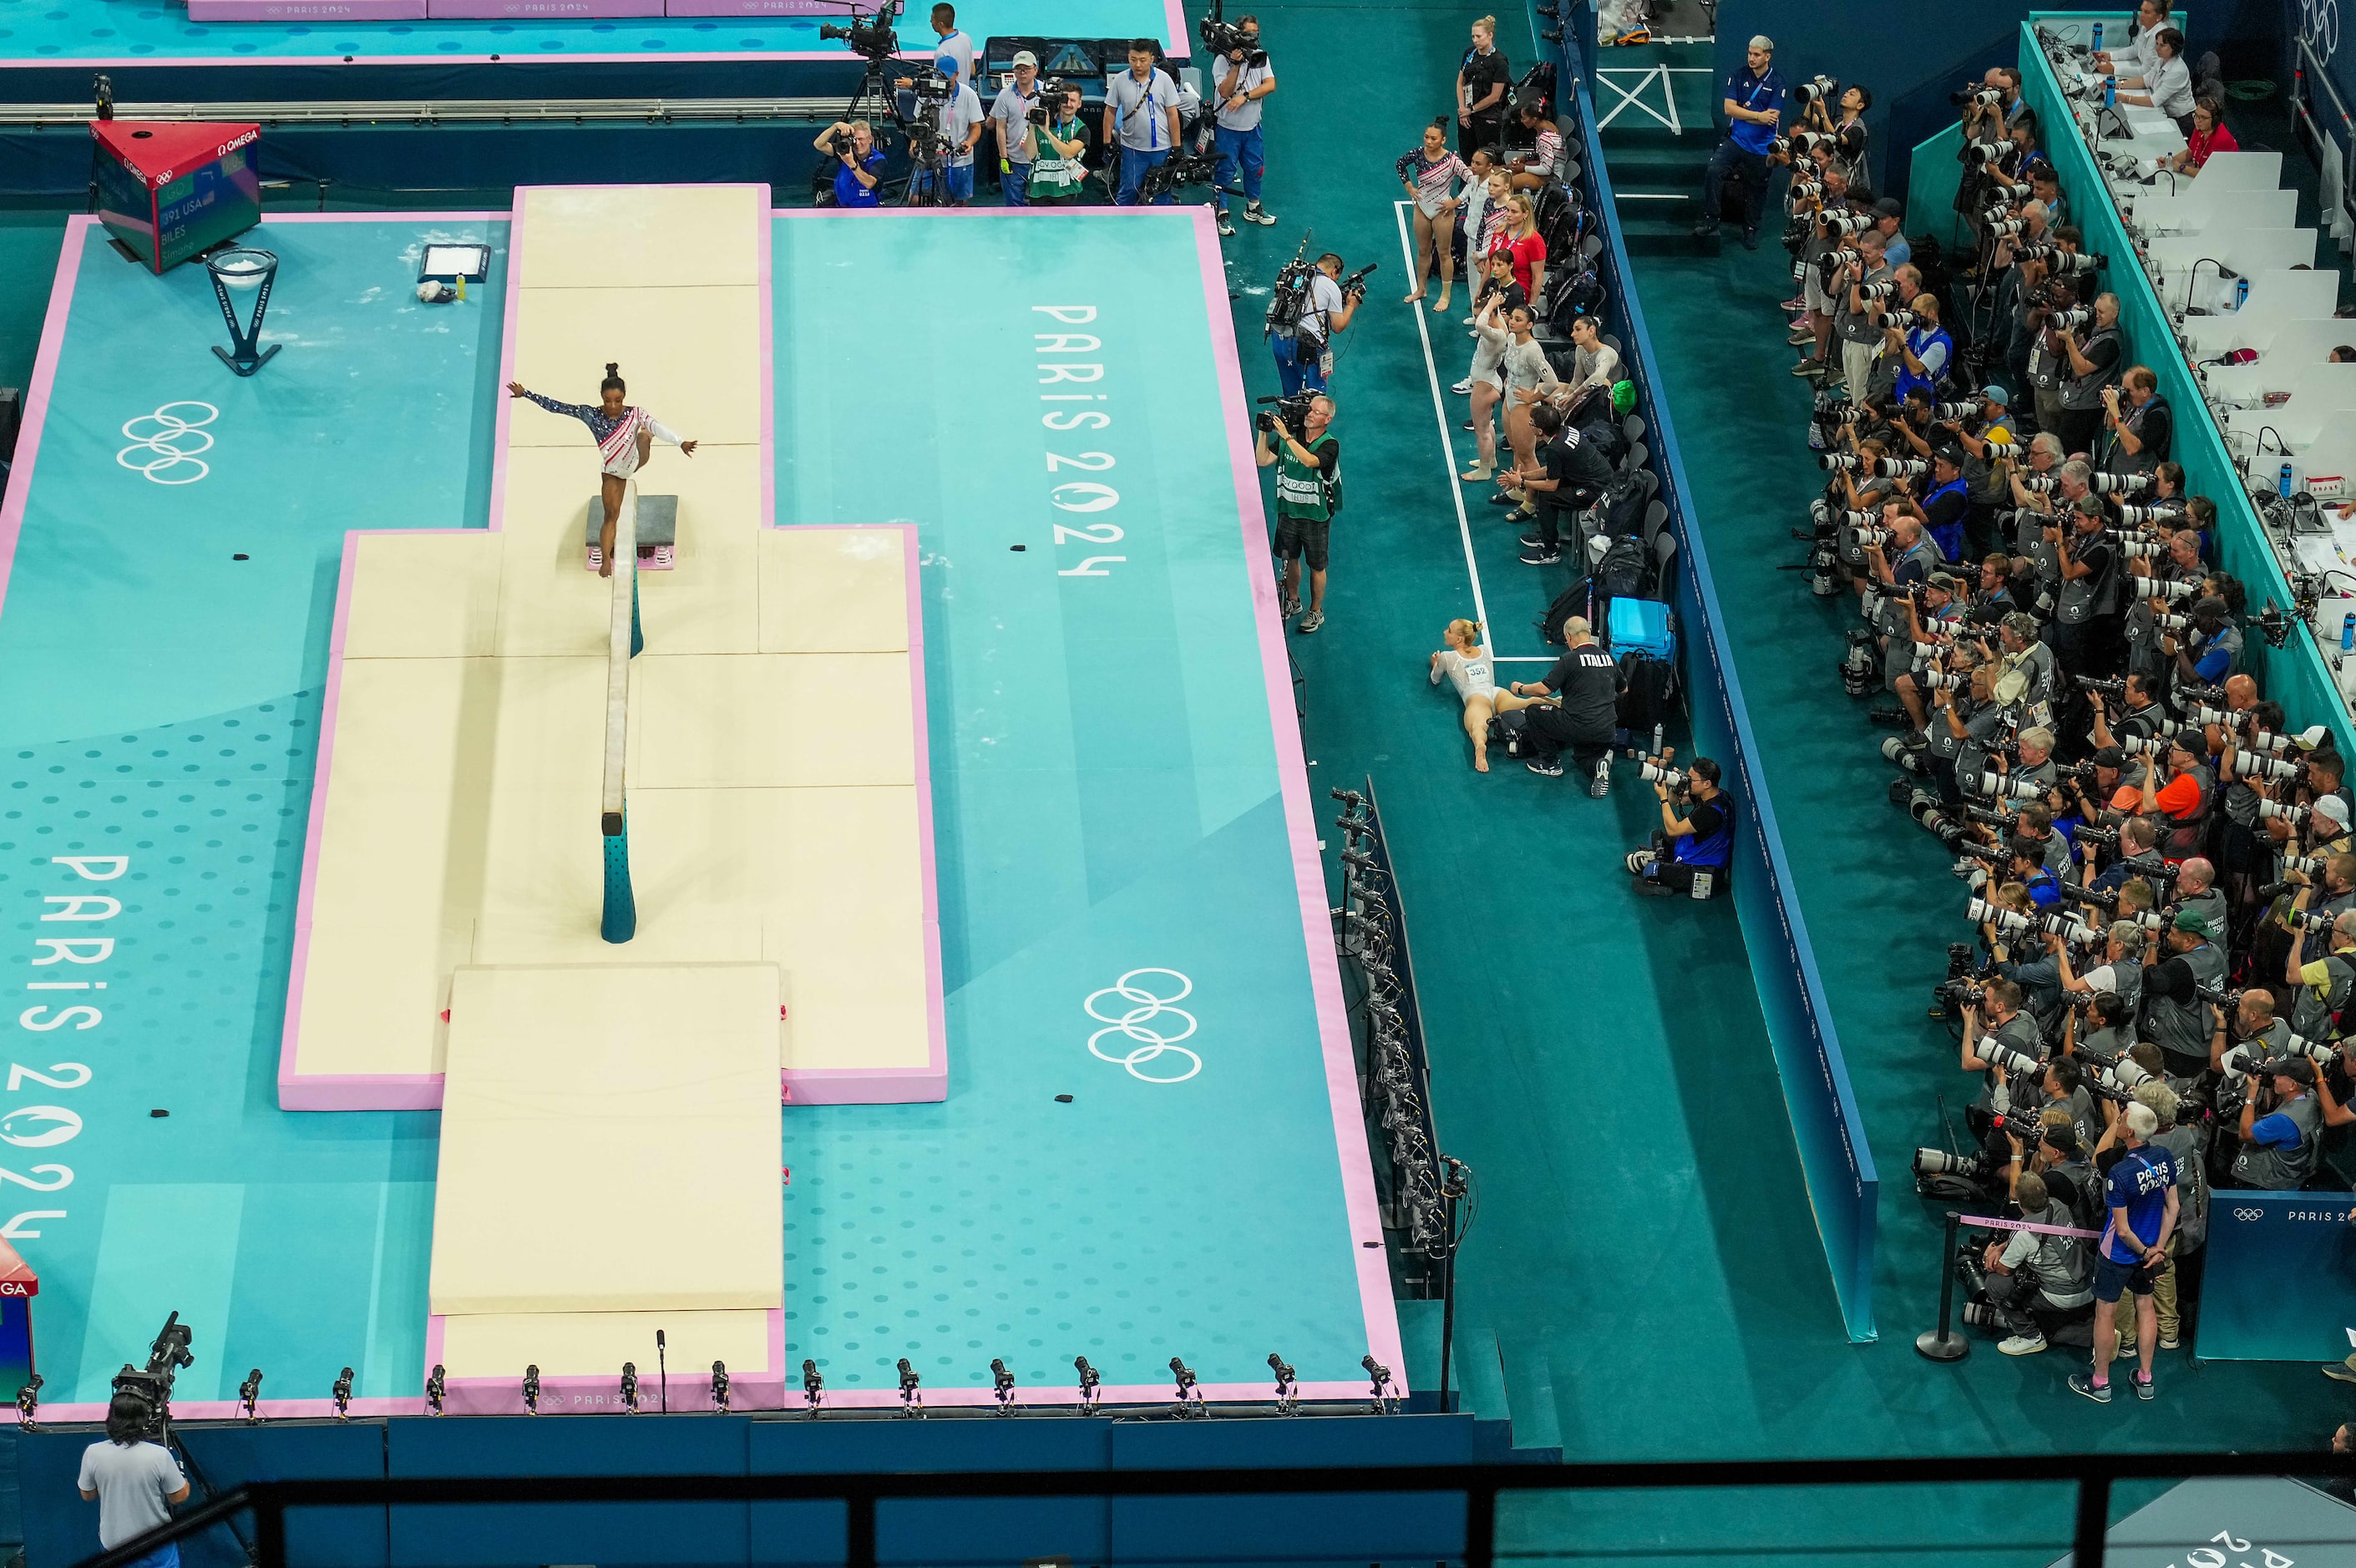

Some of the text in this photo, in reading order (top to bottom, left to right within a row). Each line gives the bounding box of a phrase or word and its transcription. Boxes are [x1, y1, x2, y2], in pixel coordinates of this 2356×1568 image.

[286, 5, 350, 14] PARIS 2024
[524, 3, 588, 12] PARIS 2024
[226, 129, 258, 152] OMEGA
[129, 163, 147, 185] OMEGA
[182, 197, 203, 215] USA
[160, 225, 186, 245] BILES
[162, 240, 195, 262] Simone
[1046, 452, 1127, 576] 2024
[1578, 654, 1614, 667] ITALIA
[1470, 667, 1487, 676] 352
[2057, 852, 2070, 871] PHOTO
[2207, 915, 2225, 928] PHOTO
[0, 1062, 93, 1238] 2024
[2288, 1211, 2332, 1222] PARIS
[1984, 1219, 2032, 1231] PARIS 2024
[574, 1394, 621, 1405] PARIS
